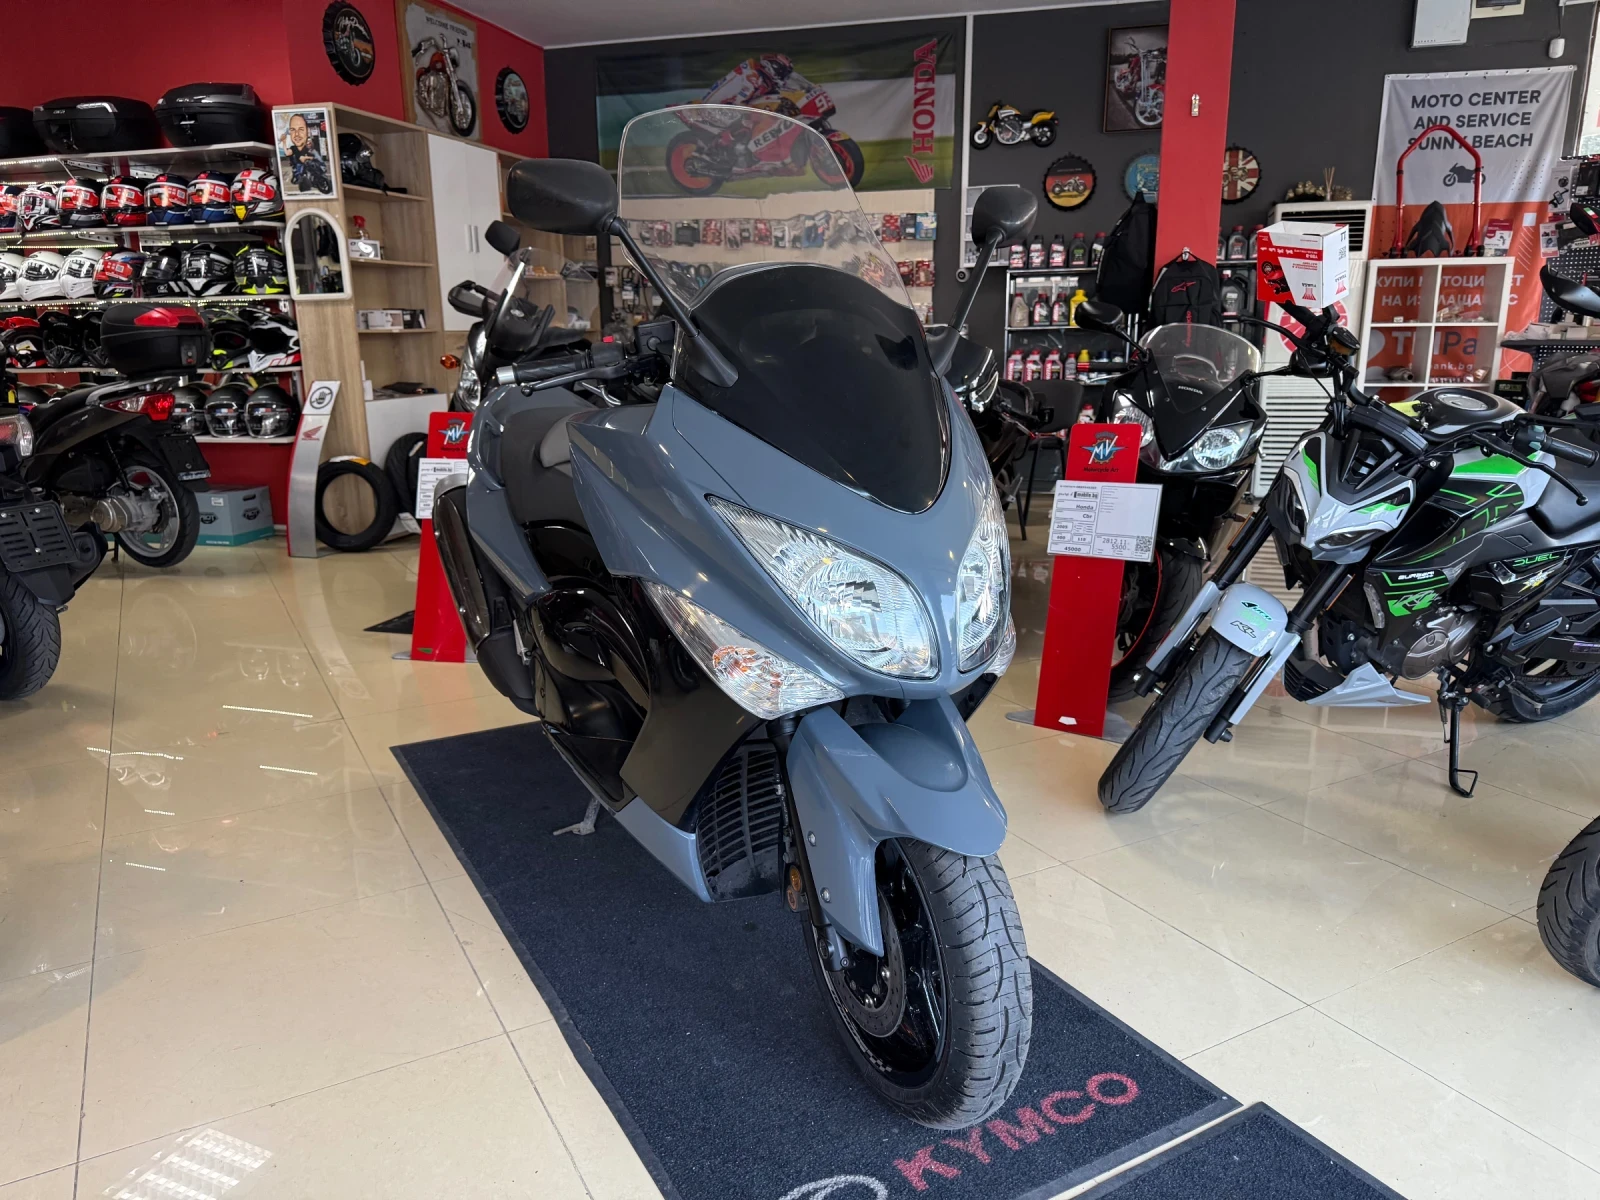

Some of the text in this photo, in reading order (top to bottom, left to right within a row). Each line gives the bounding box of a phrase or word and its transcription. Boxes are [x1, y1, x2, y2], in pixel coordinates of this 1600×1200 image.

[912, 38, 937, 155] HONDA
[1411, 90, 1541, 109] MOTO CENTER
[1413, 112, 1532, 130] AND SERVICE
[1472, 133, 1533, 149] BEACH
[1381, 295, 1403, 307] НА
[1178, 385, 1203, 395] HONDA
[1088, 436, 1119, 465] MV
[893, 1072, 1139, 1191] KYMCO
